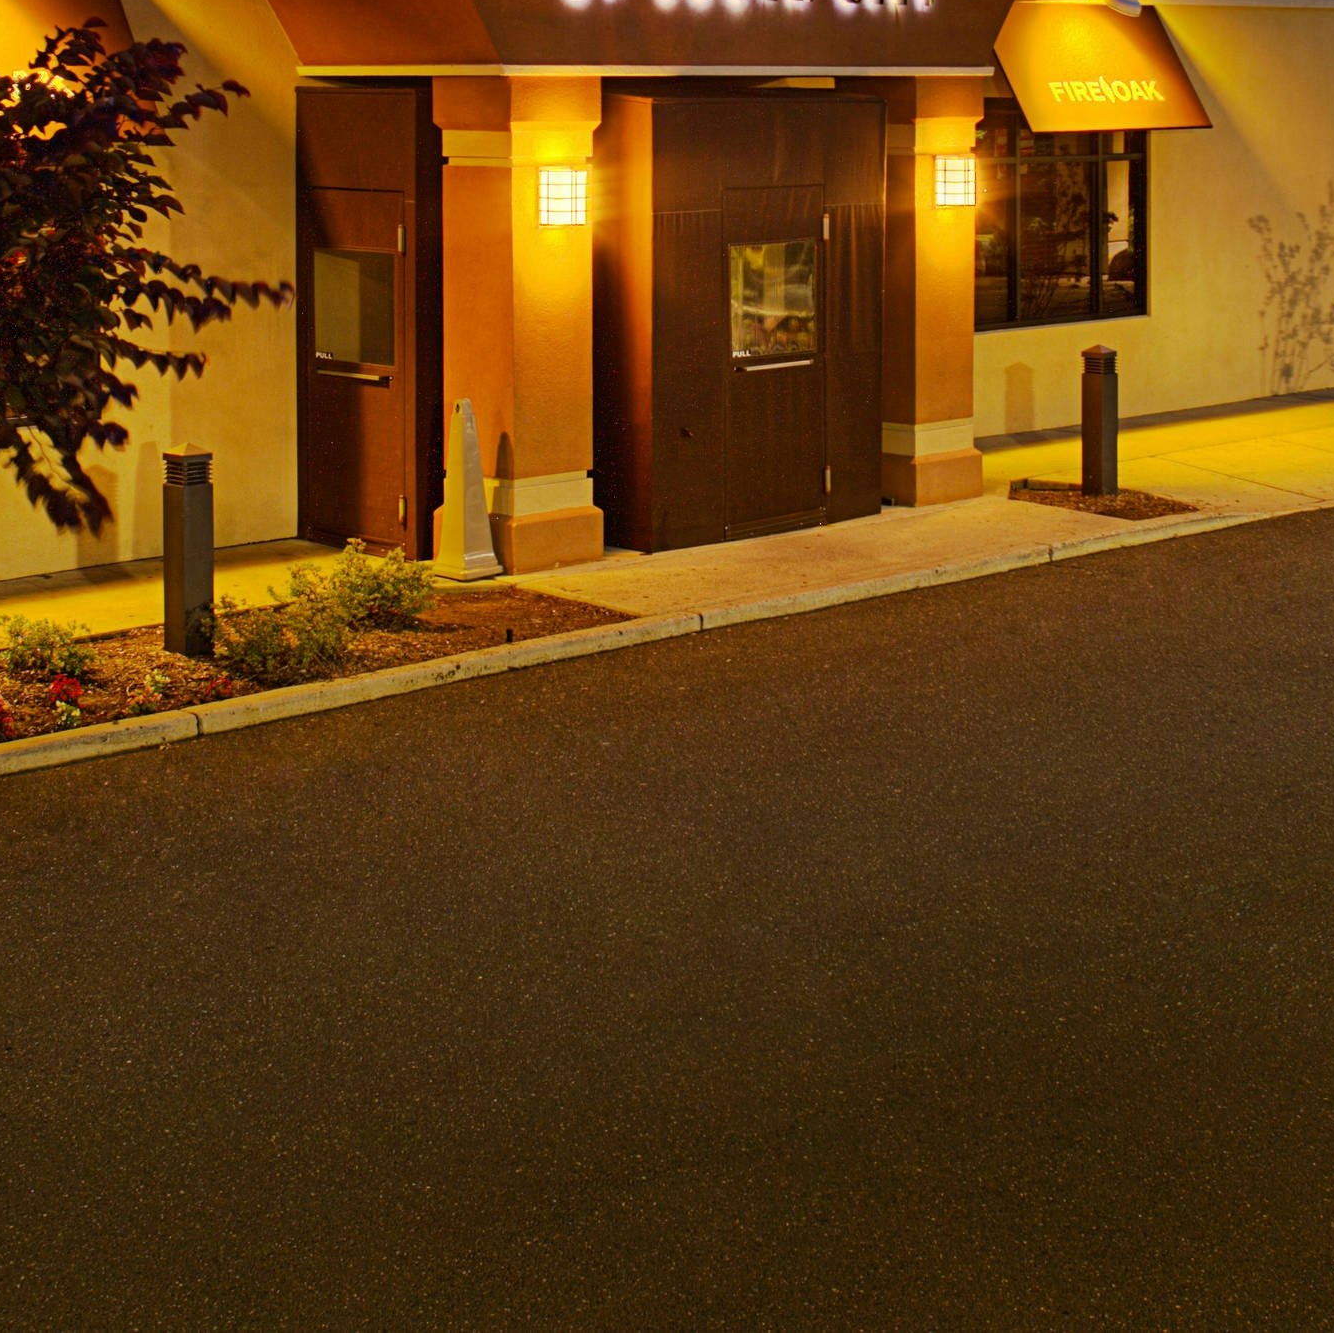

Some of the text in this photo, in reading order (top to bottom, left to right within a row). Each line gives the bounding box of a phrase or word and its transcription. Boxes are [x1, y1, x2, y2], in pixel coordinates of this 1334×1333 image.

[1047, 79, 1166, 103] FIRE OAK
[315, 351, 333, 360] PULL
[732, 349, 751, 358] PULL
